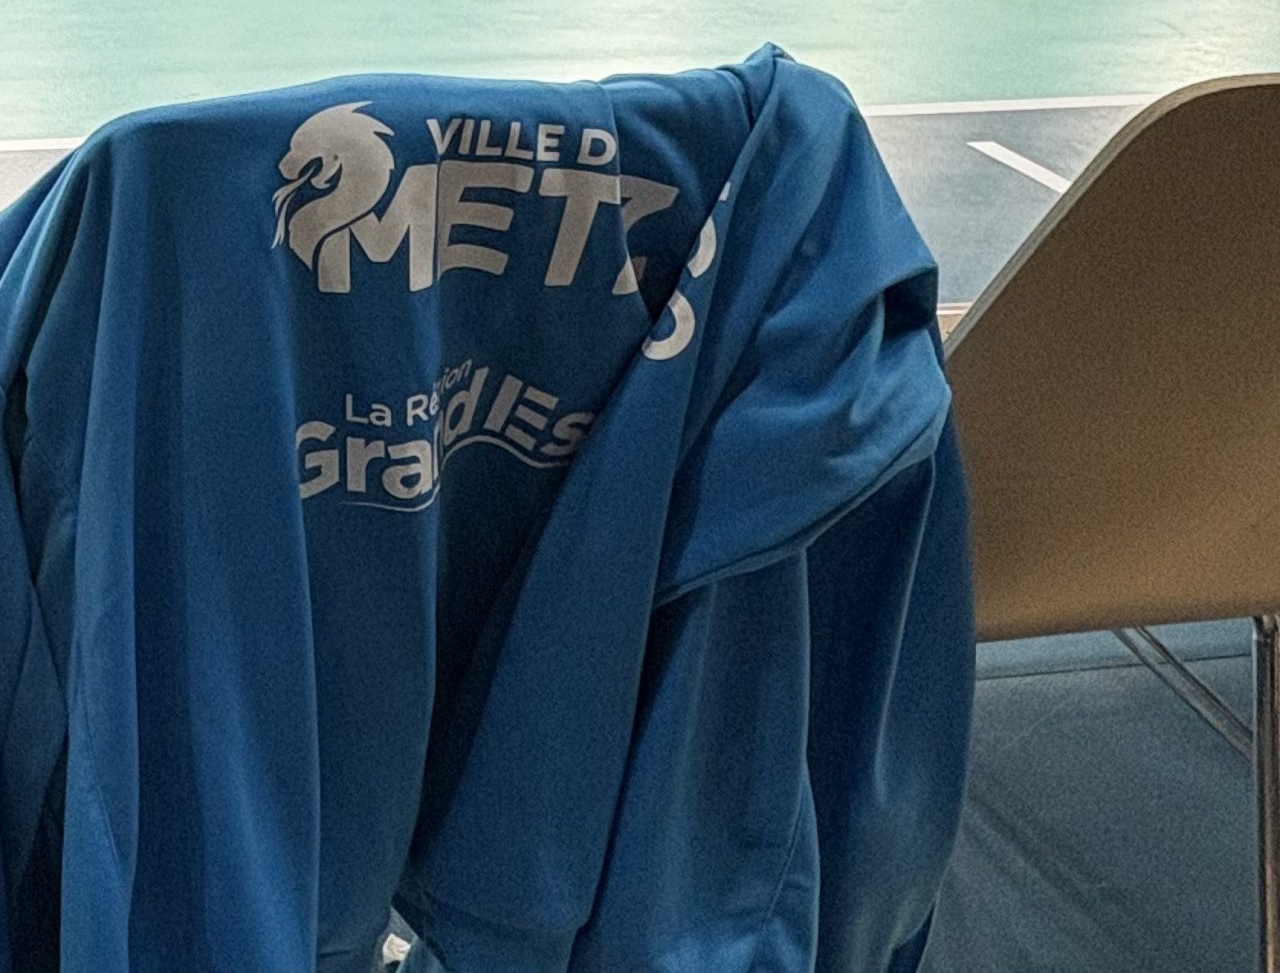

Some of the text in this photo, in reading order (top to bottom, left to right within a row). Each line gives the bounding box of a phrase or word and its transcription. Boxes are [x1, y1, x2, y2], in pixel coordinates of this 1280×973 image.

[426, 118, 618, 166] VILLE D
[345, 393, 392, 427] La
